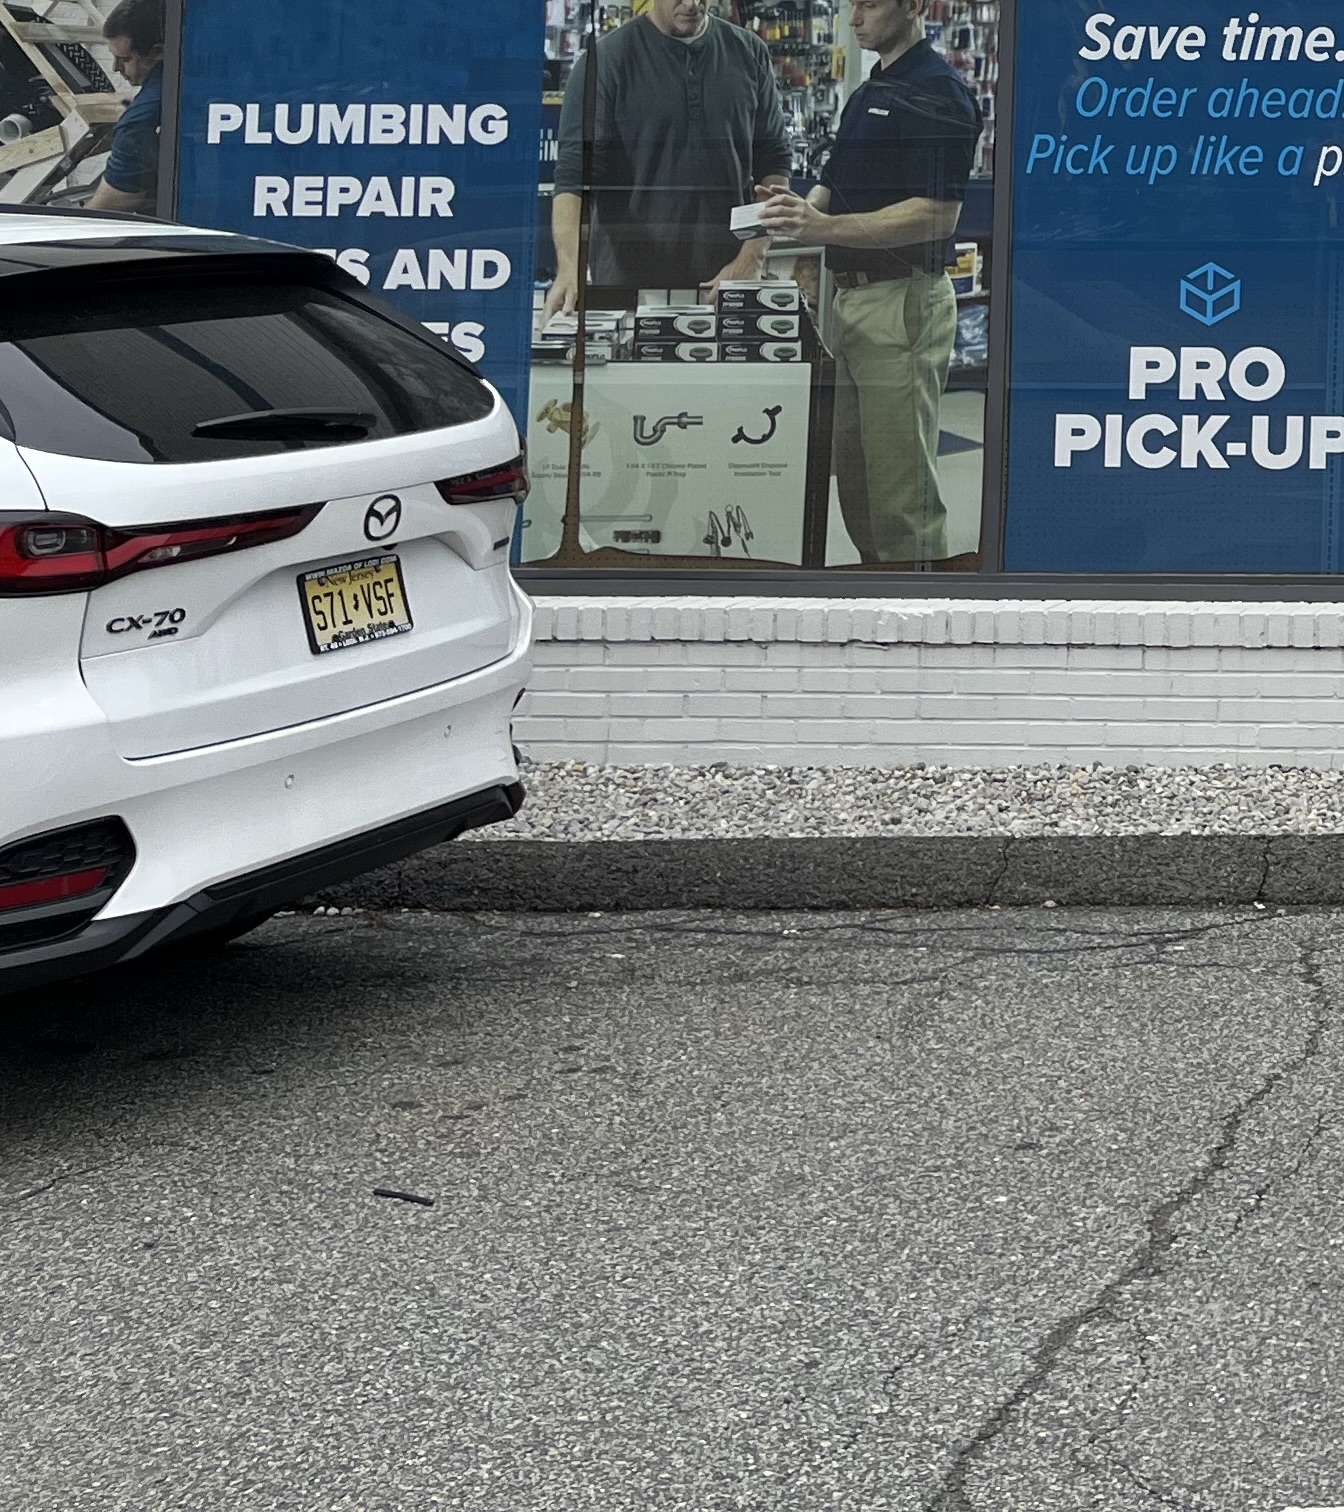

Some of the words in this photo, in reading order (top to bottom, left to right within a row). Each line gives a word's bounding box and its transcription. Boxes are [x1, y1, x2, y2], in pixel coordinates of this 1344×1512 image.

[1079, 14, 1205, 60] Save
[1076, 77, 1197, 117] Order
[208, 104, 508, 144] PLUMBING
[1026, 135, 1114, 174] Pick
[1126, 145, 1177, 184] up
[1191, 135, 1263, 175] like
[1278, 146, 1304, 175] a
[254, 176, 454, 216] REPAIR
[383, 249, 510, 289] AND
[1129, 347, 1285, 401] PRO
[105, 608, 186, 634] CX-70
